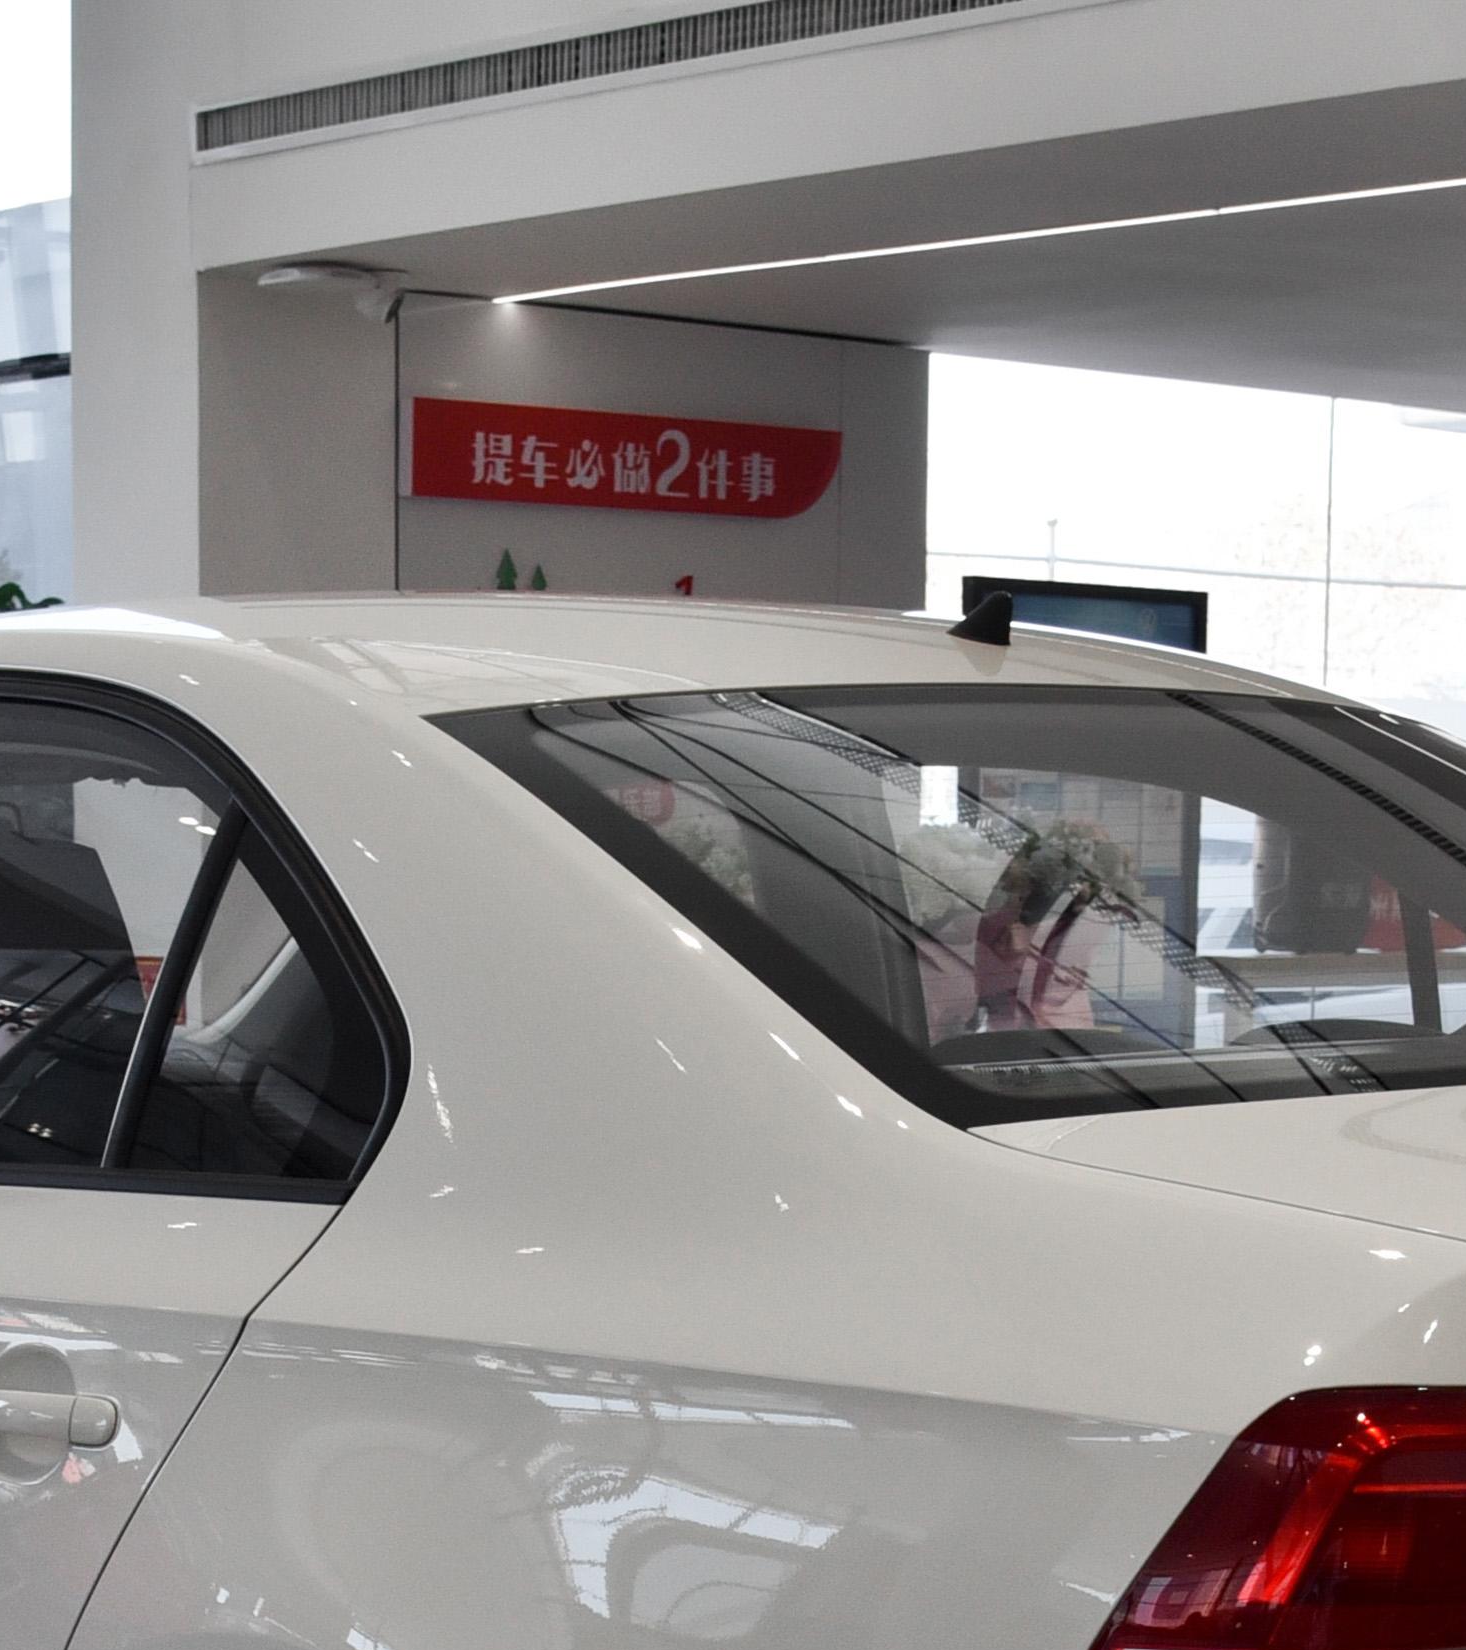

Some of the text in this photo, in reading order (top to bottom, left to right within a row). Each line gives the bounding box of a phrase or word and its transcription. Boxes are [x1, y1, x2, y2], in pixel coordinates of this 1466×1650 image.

[471, 429, 777, 502] 提车必做2件事
